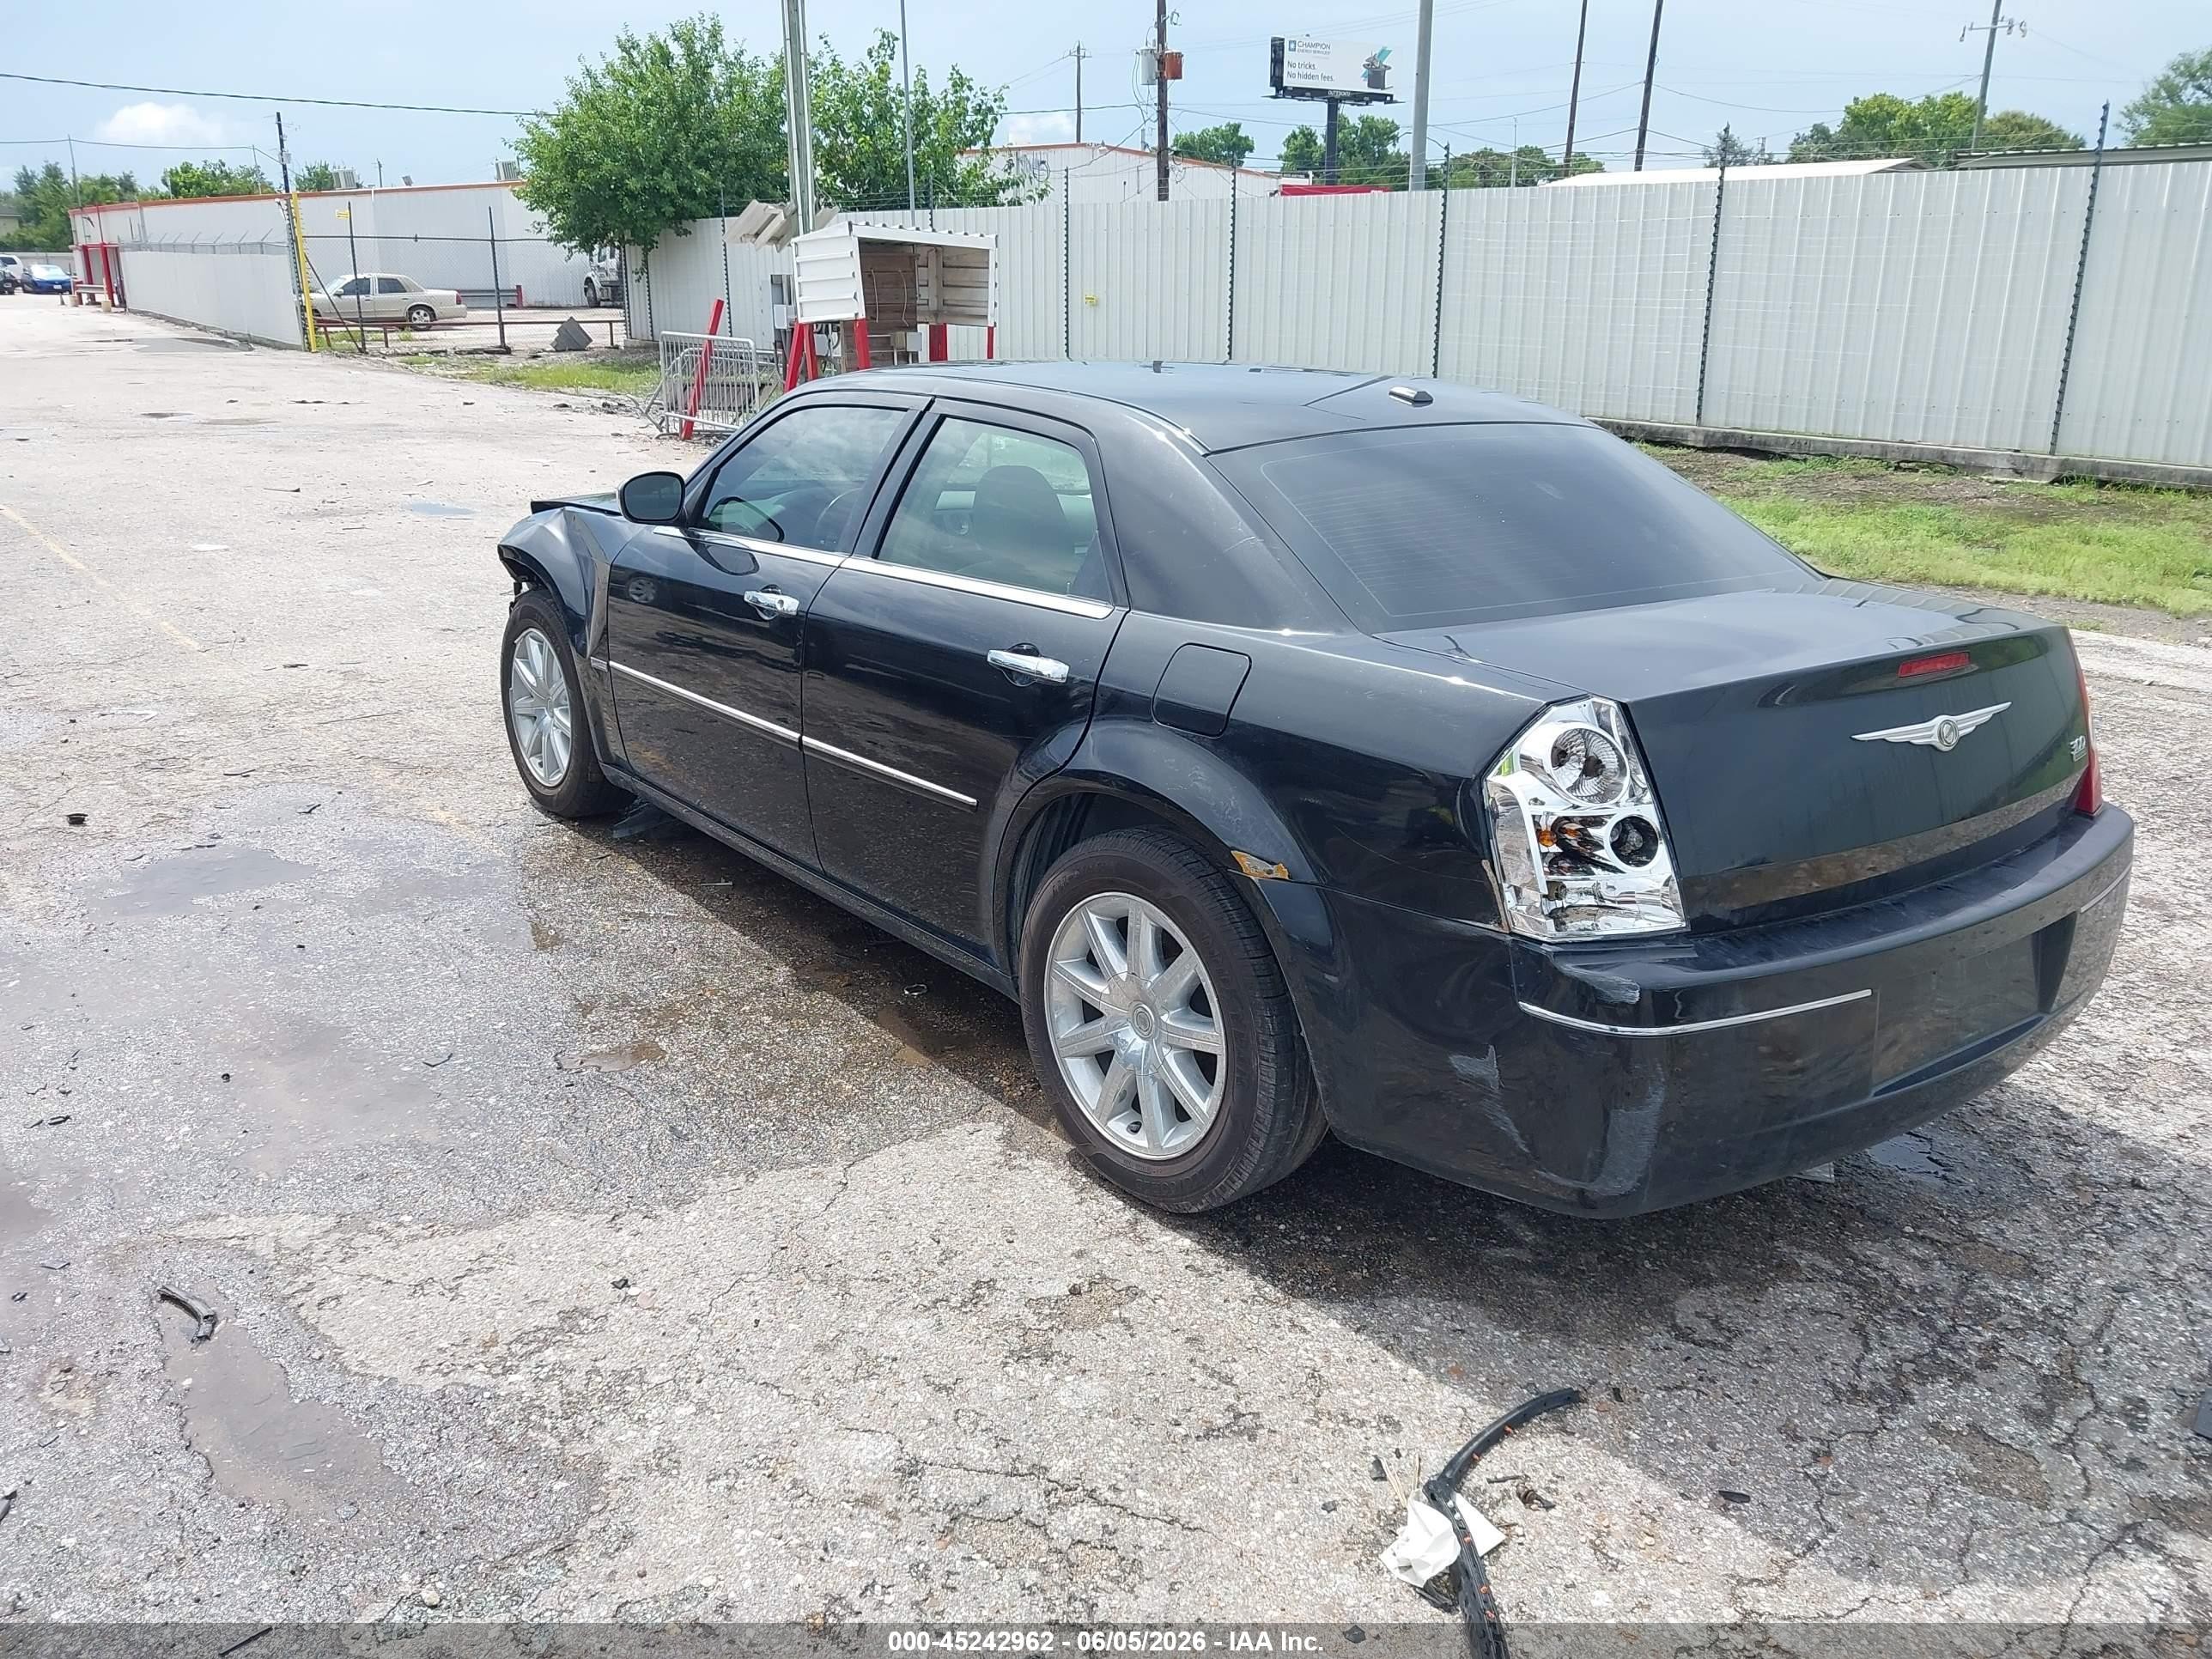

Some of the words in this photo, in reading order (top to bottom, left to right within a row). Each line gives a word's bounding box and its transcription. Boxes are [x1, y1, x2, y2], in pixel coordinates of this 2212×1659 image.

[1297, 40, 1331, 50] CHAMPION
[1287, 60, 1297, 69] No
[1297, 61, 1317, 70] tricks.
[1287, 70, 1297, 79] No
[1297, 70, 1320, 81] hidden
[1320, 72, 1335, 82] fees.
